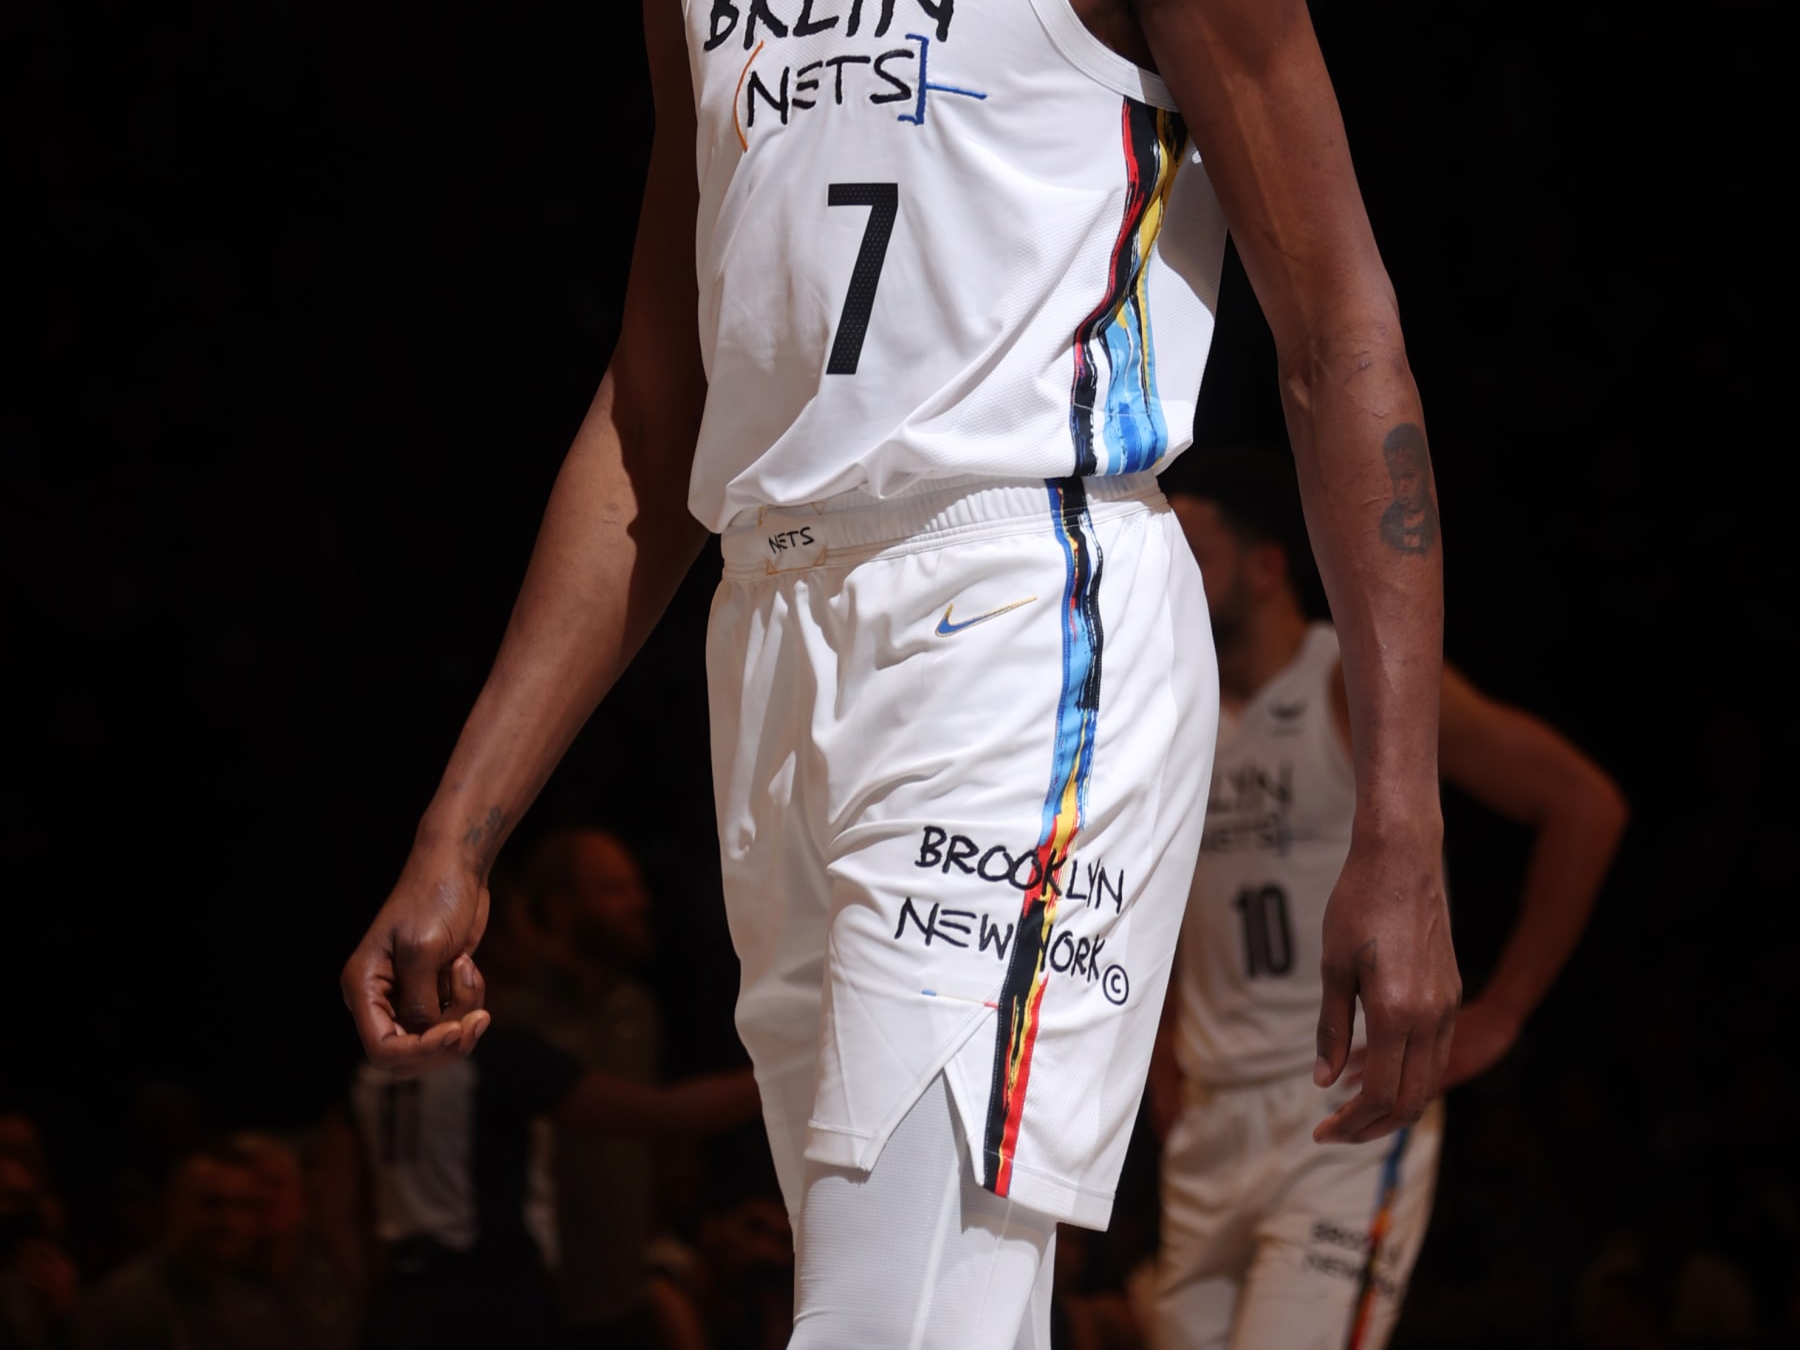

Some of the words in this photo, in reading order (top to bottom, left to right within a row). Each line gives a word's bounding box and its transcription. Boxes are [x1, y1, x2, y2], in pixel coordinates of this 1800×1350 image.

[825, 182, 899, 375] 7
[768, 526, 815, 555] NETS
[914, 825, 1125, 915] BROOKLYN
[894, 896, 1014, 961] NEW
[1030, 922, 1106, 983] YORK
[1231, 881, 1298, 980] 10
